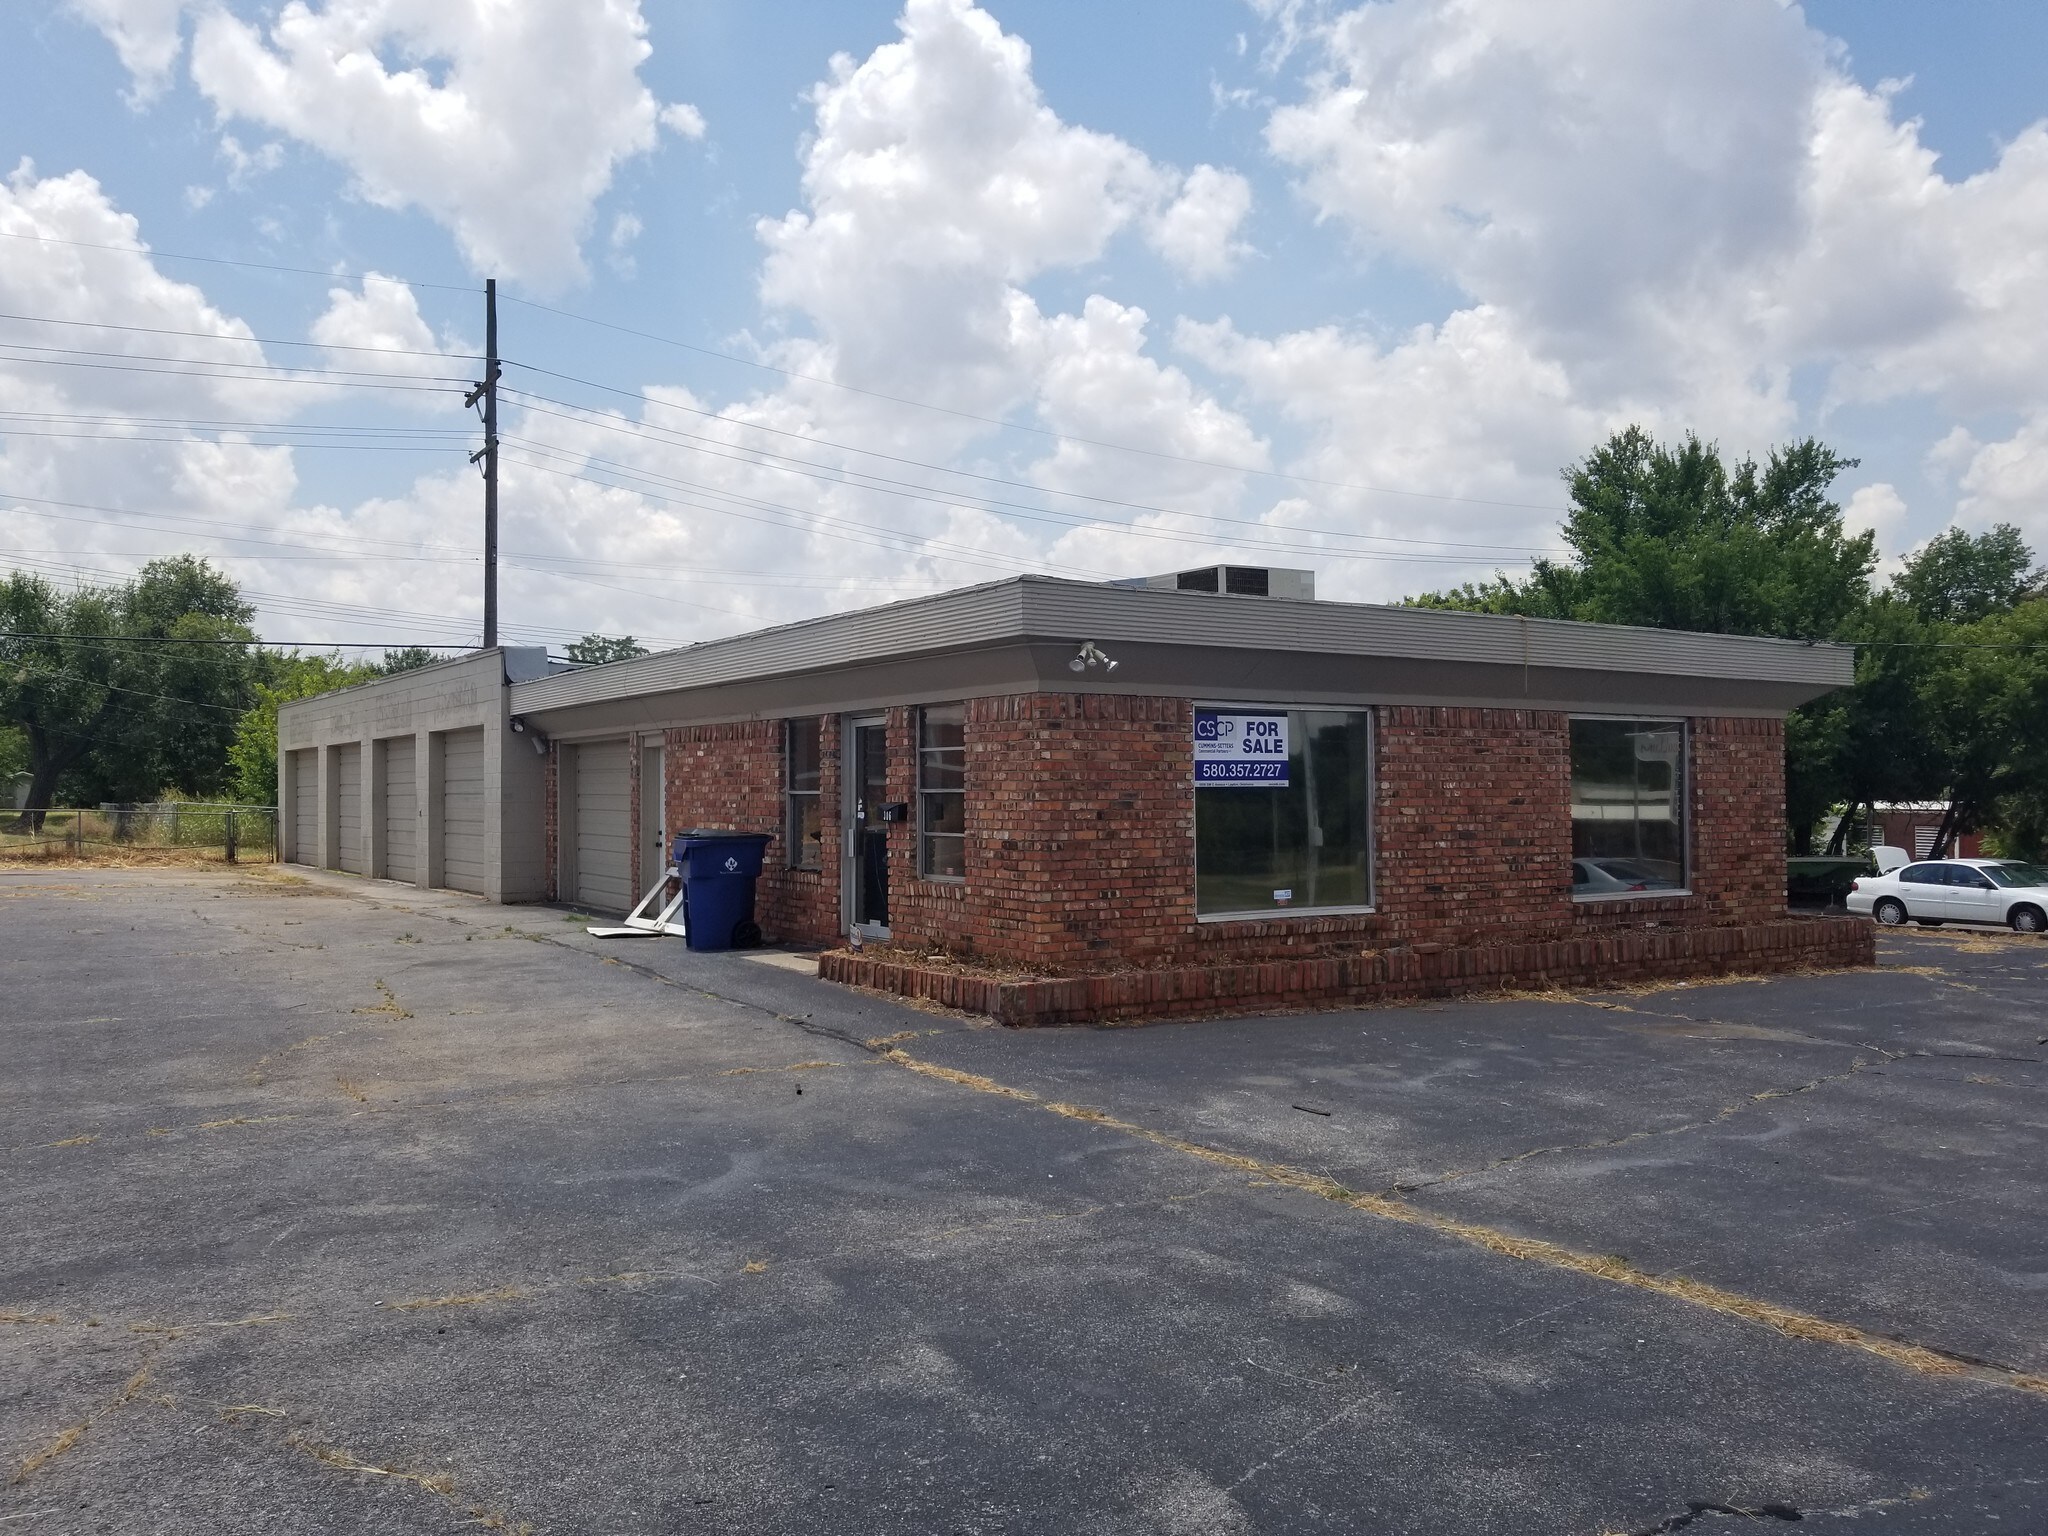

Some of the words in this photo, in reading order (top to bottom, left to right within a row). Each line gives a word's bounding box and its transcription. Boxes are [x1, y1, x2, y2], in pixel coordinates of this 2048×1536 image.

[1197, 720, 1234, 737] CSCP
[1246, 721, 1279, 737] FOR
[1242, 738, 1284, 754] SALE
[1203, 763, 1282, 777] 580.357.2727
